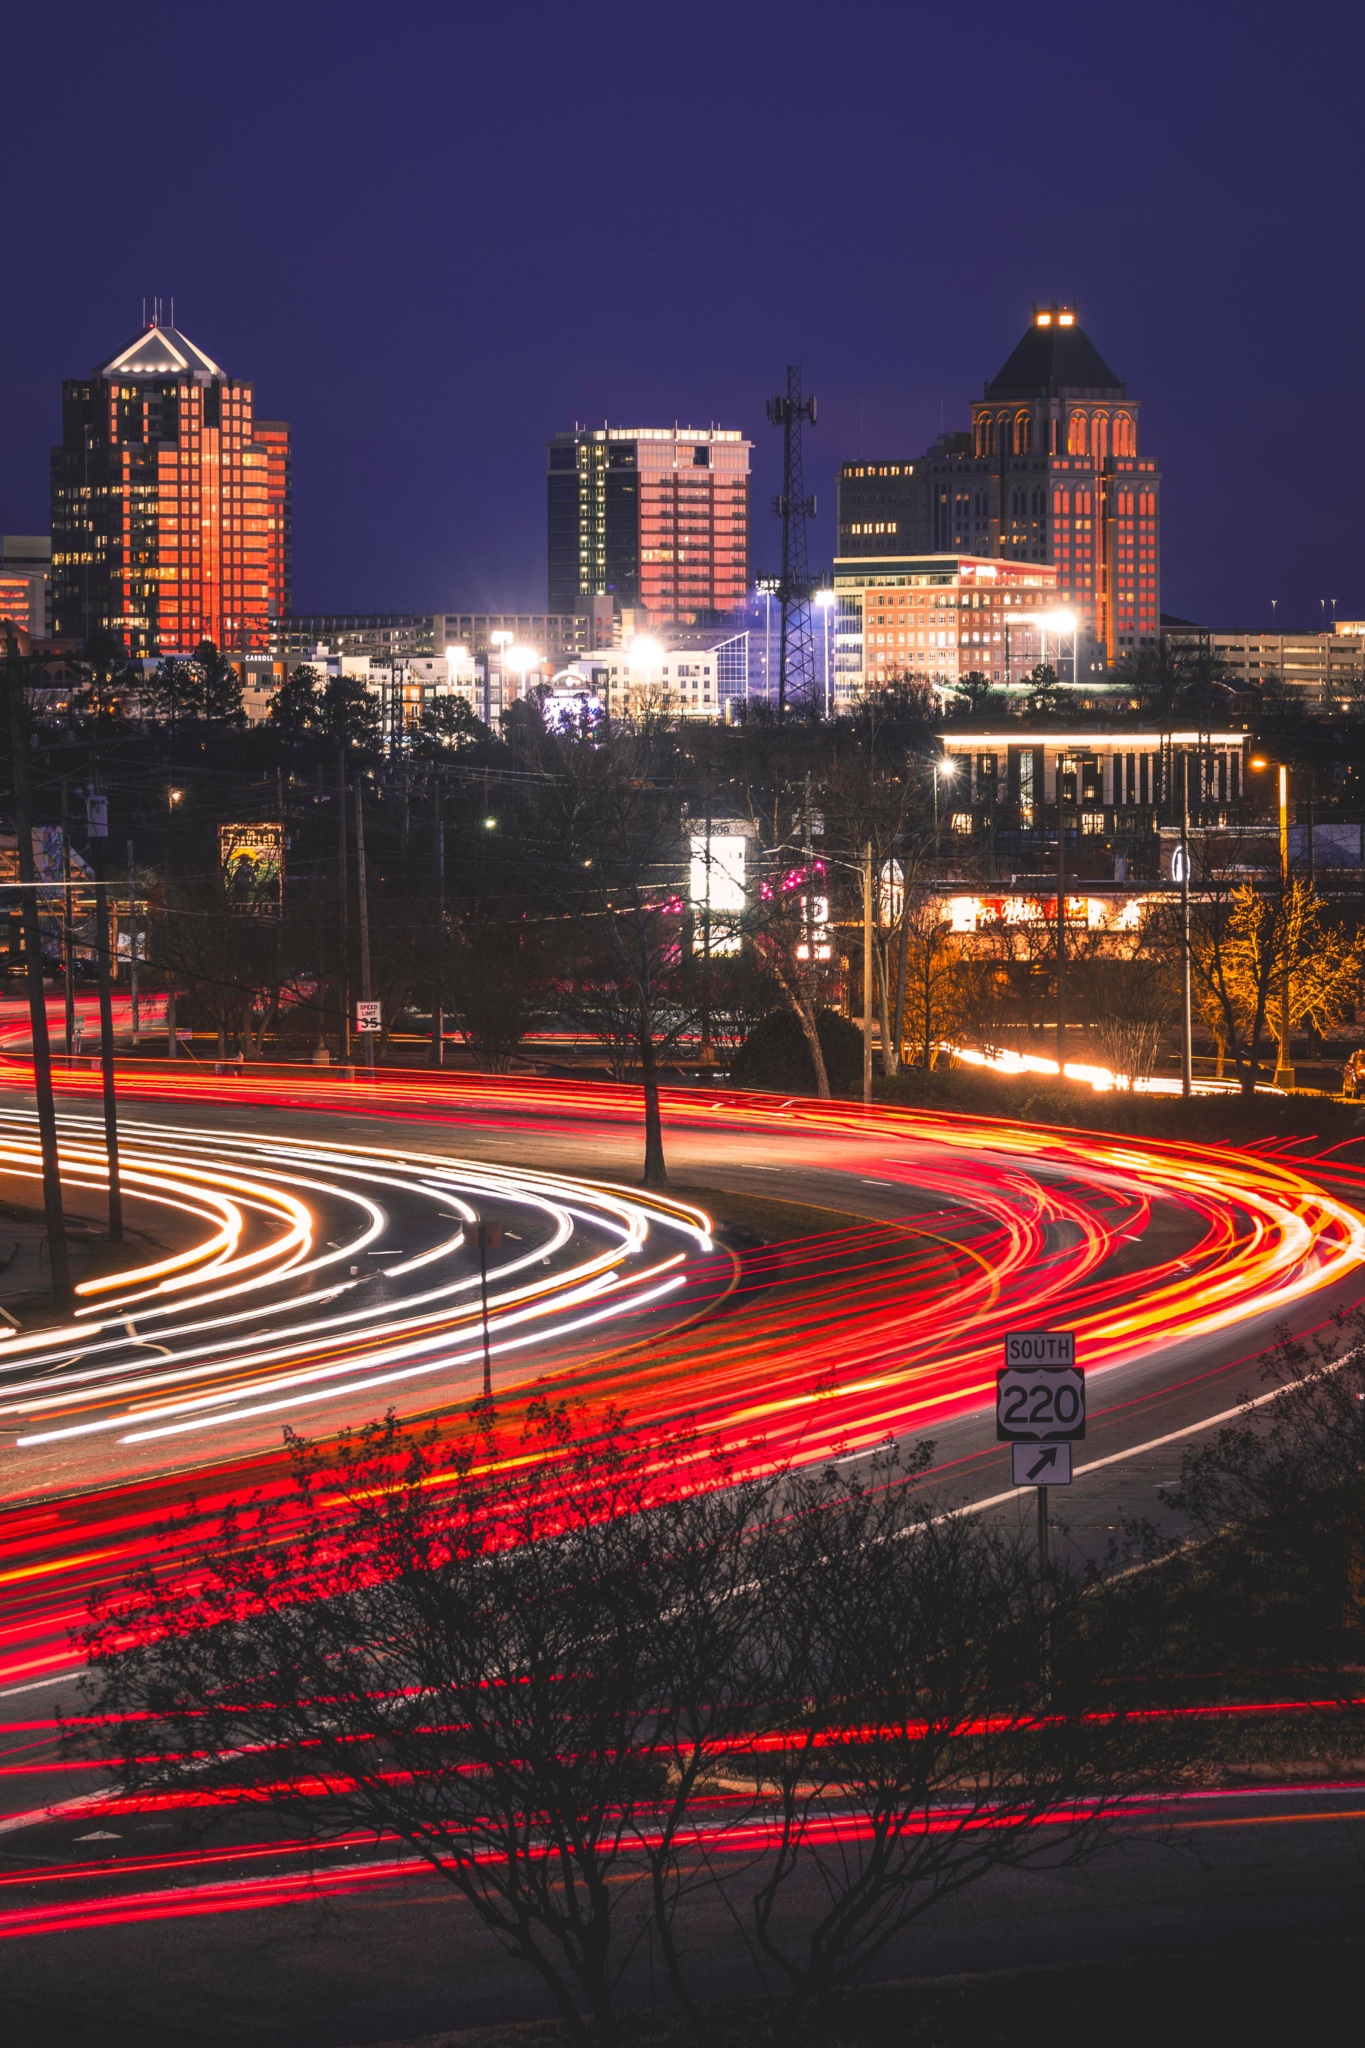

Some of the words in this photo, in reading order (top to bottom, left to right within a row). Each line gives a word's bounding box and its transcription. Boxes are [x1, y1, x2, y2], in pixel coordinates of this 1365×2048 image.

[361, 1017, 378, 1029] 35
[1010, 1339, 1070, 1359] SOUTH
[1003, 1385, 1080, 1423] 220
